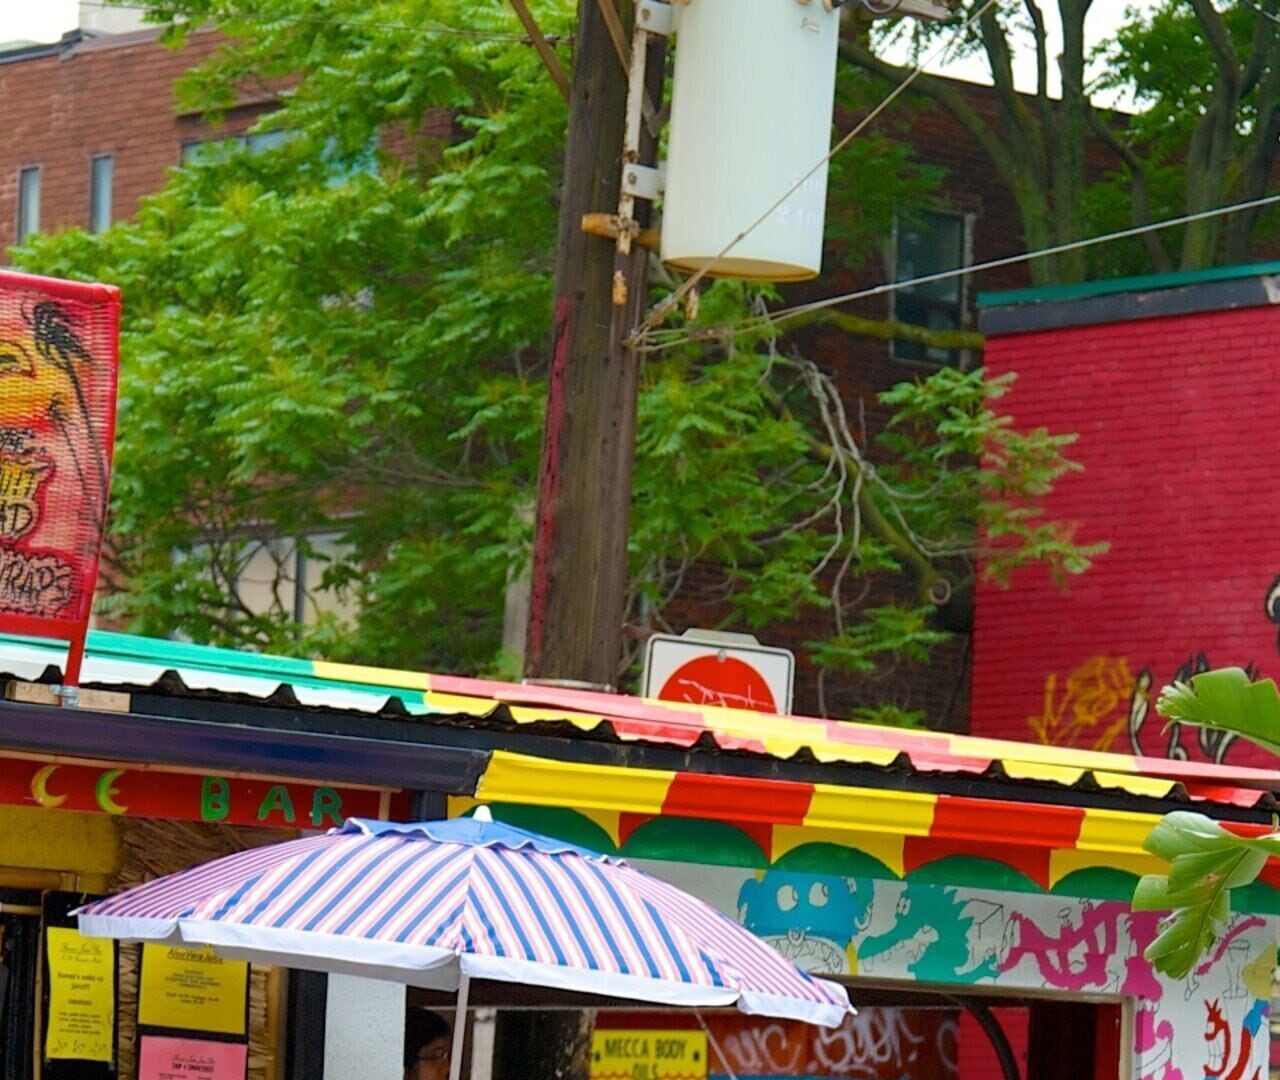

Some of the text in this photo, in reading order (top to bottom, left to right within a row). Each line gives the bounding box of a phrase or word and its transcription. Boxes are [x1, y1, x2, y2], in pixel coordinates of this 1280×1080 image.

[200, 774, 344, 827] BAR
[604, 1038, 687, 1060] MECCA BODY
